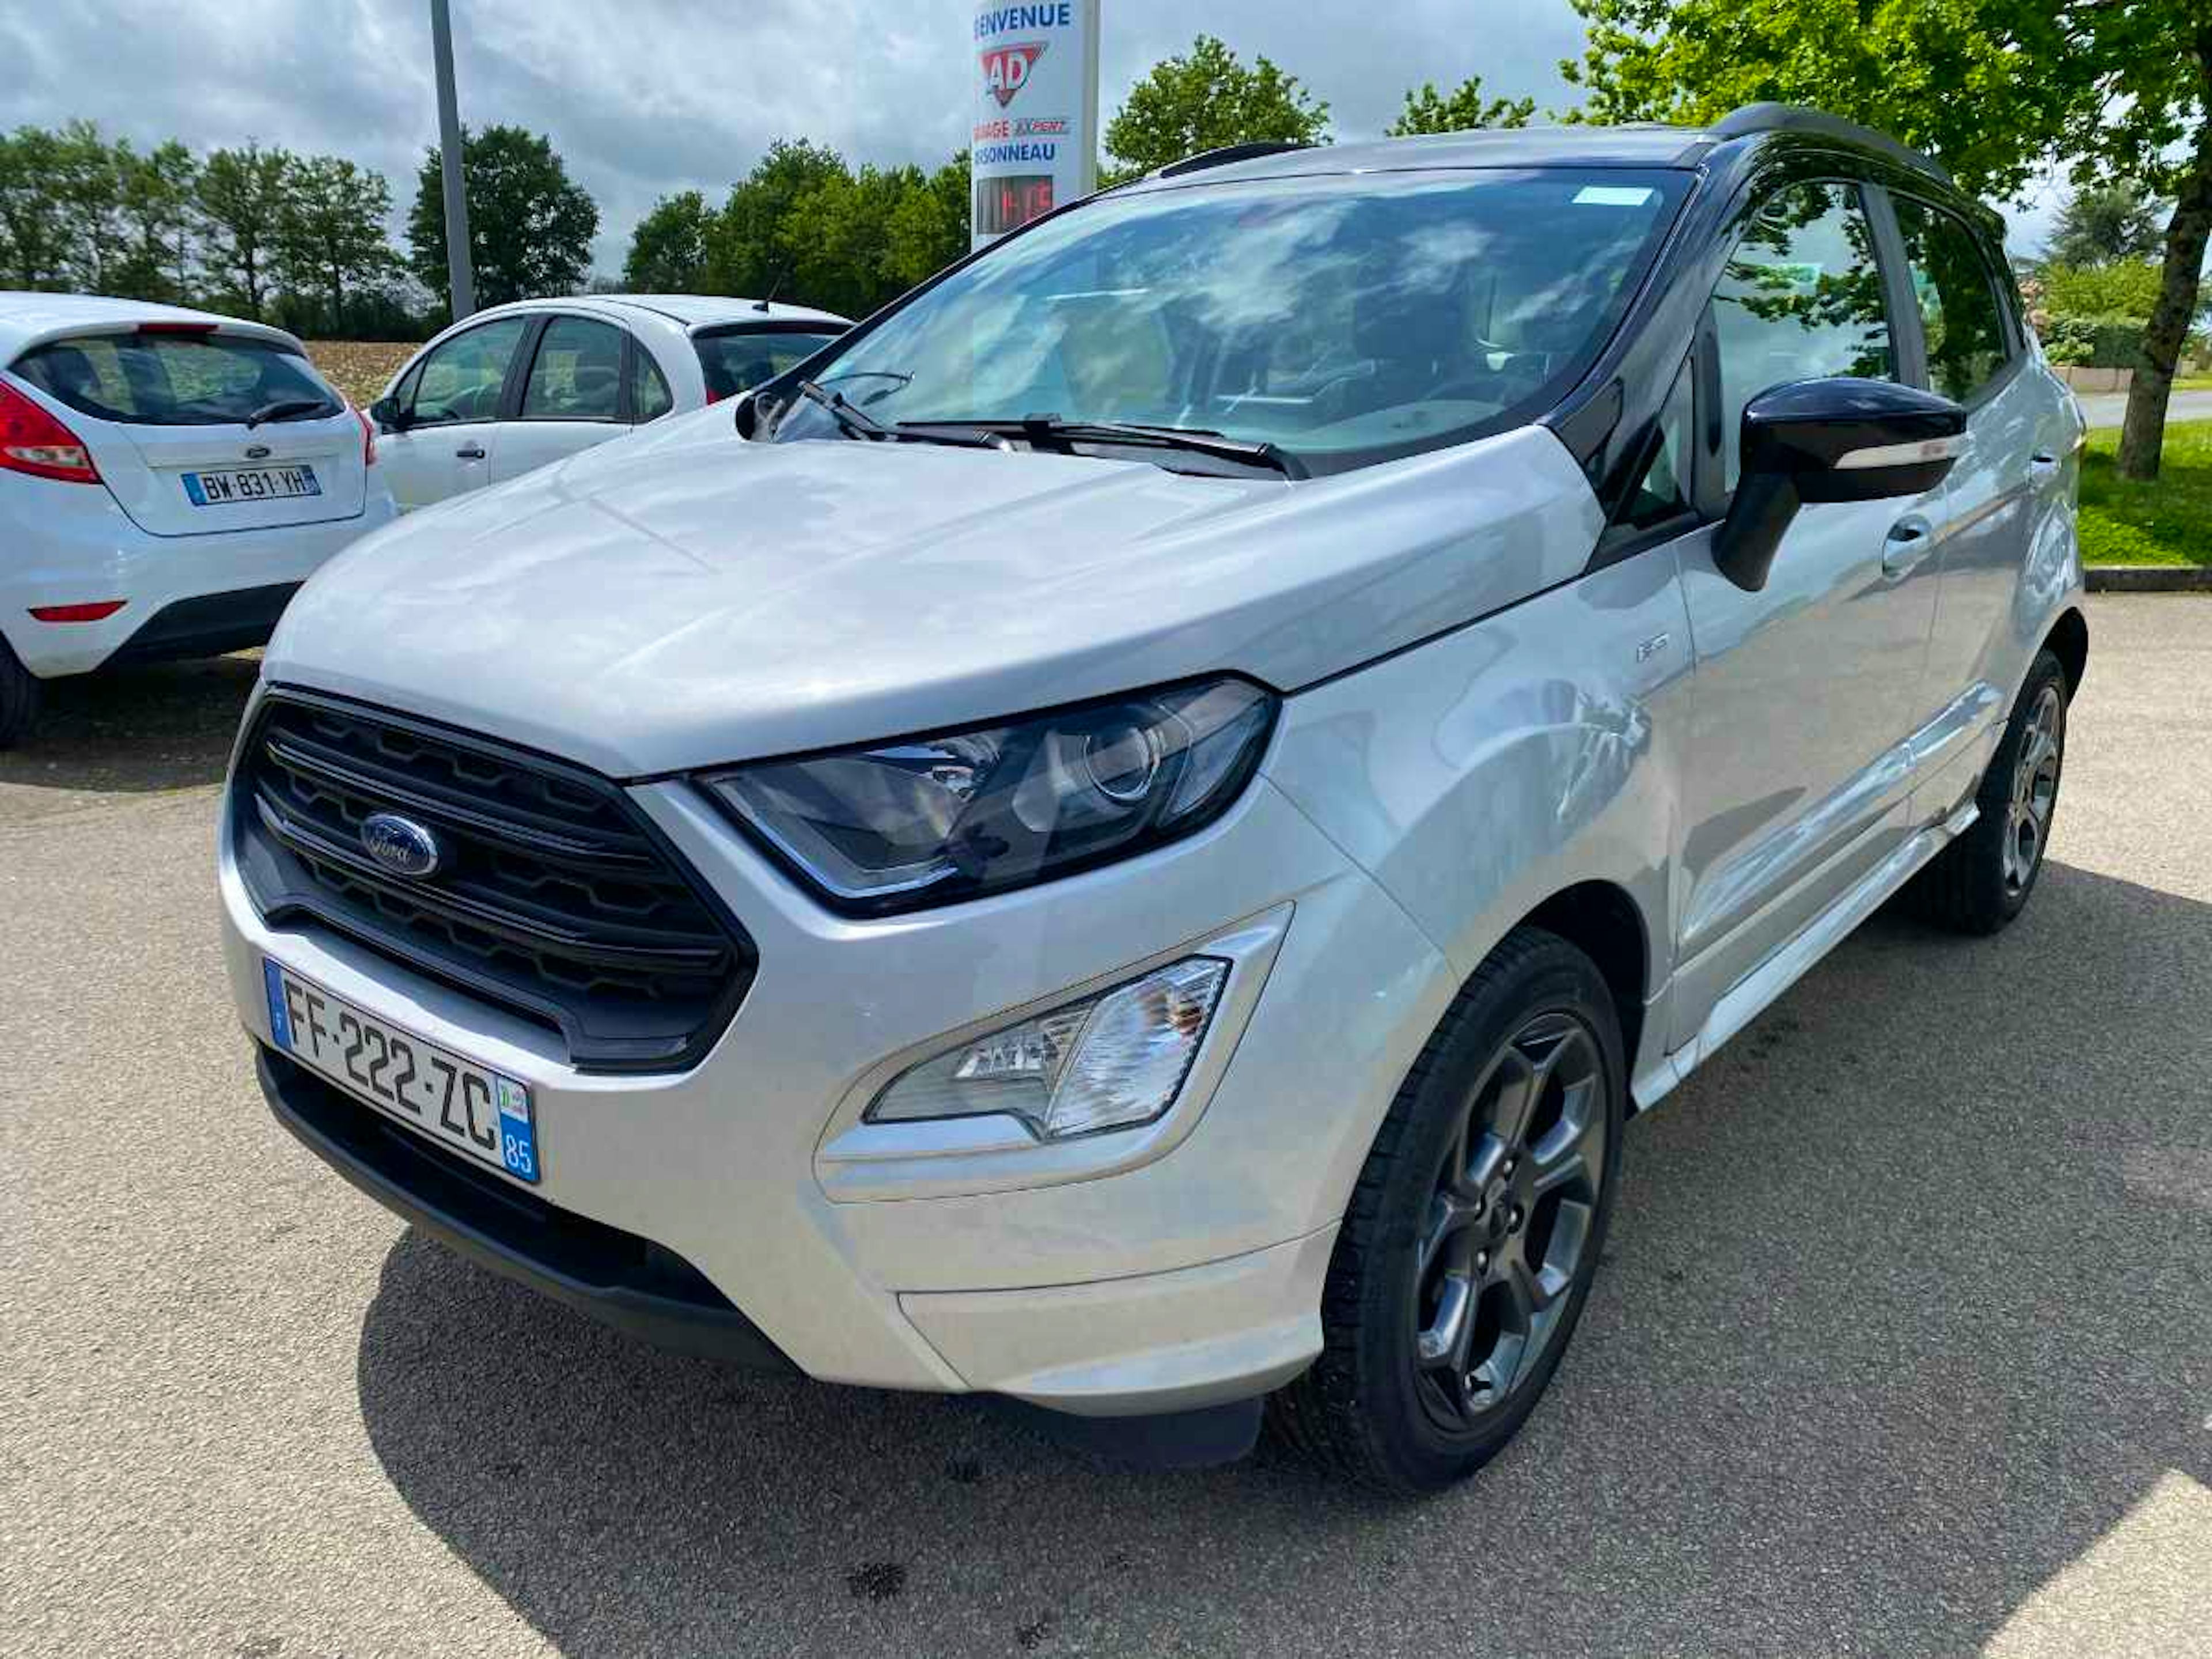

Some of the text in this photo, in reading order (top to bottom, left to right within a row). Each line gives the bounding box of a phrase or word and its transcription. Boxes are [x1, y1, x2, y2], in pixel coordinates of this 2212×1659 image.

[989, 51, 1028, 90] AD
[284, 979, 496, 1150] FF-222-ZC
[506, 1134, 532, 1173] 85
